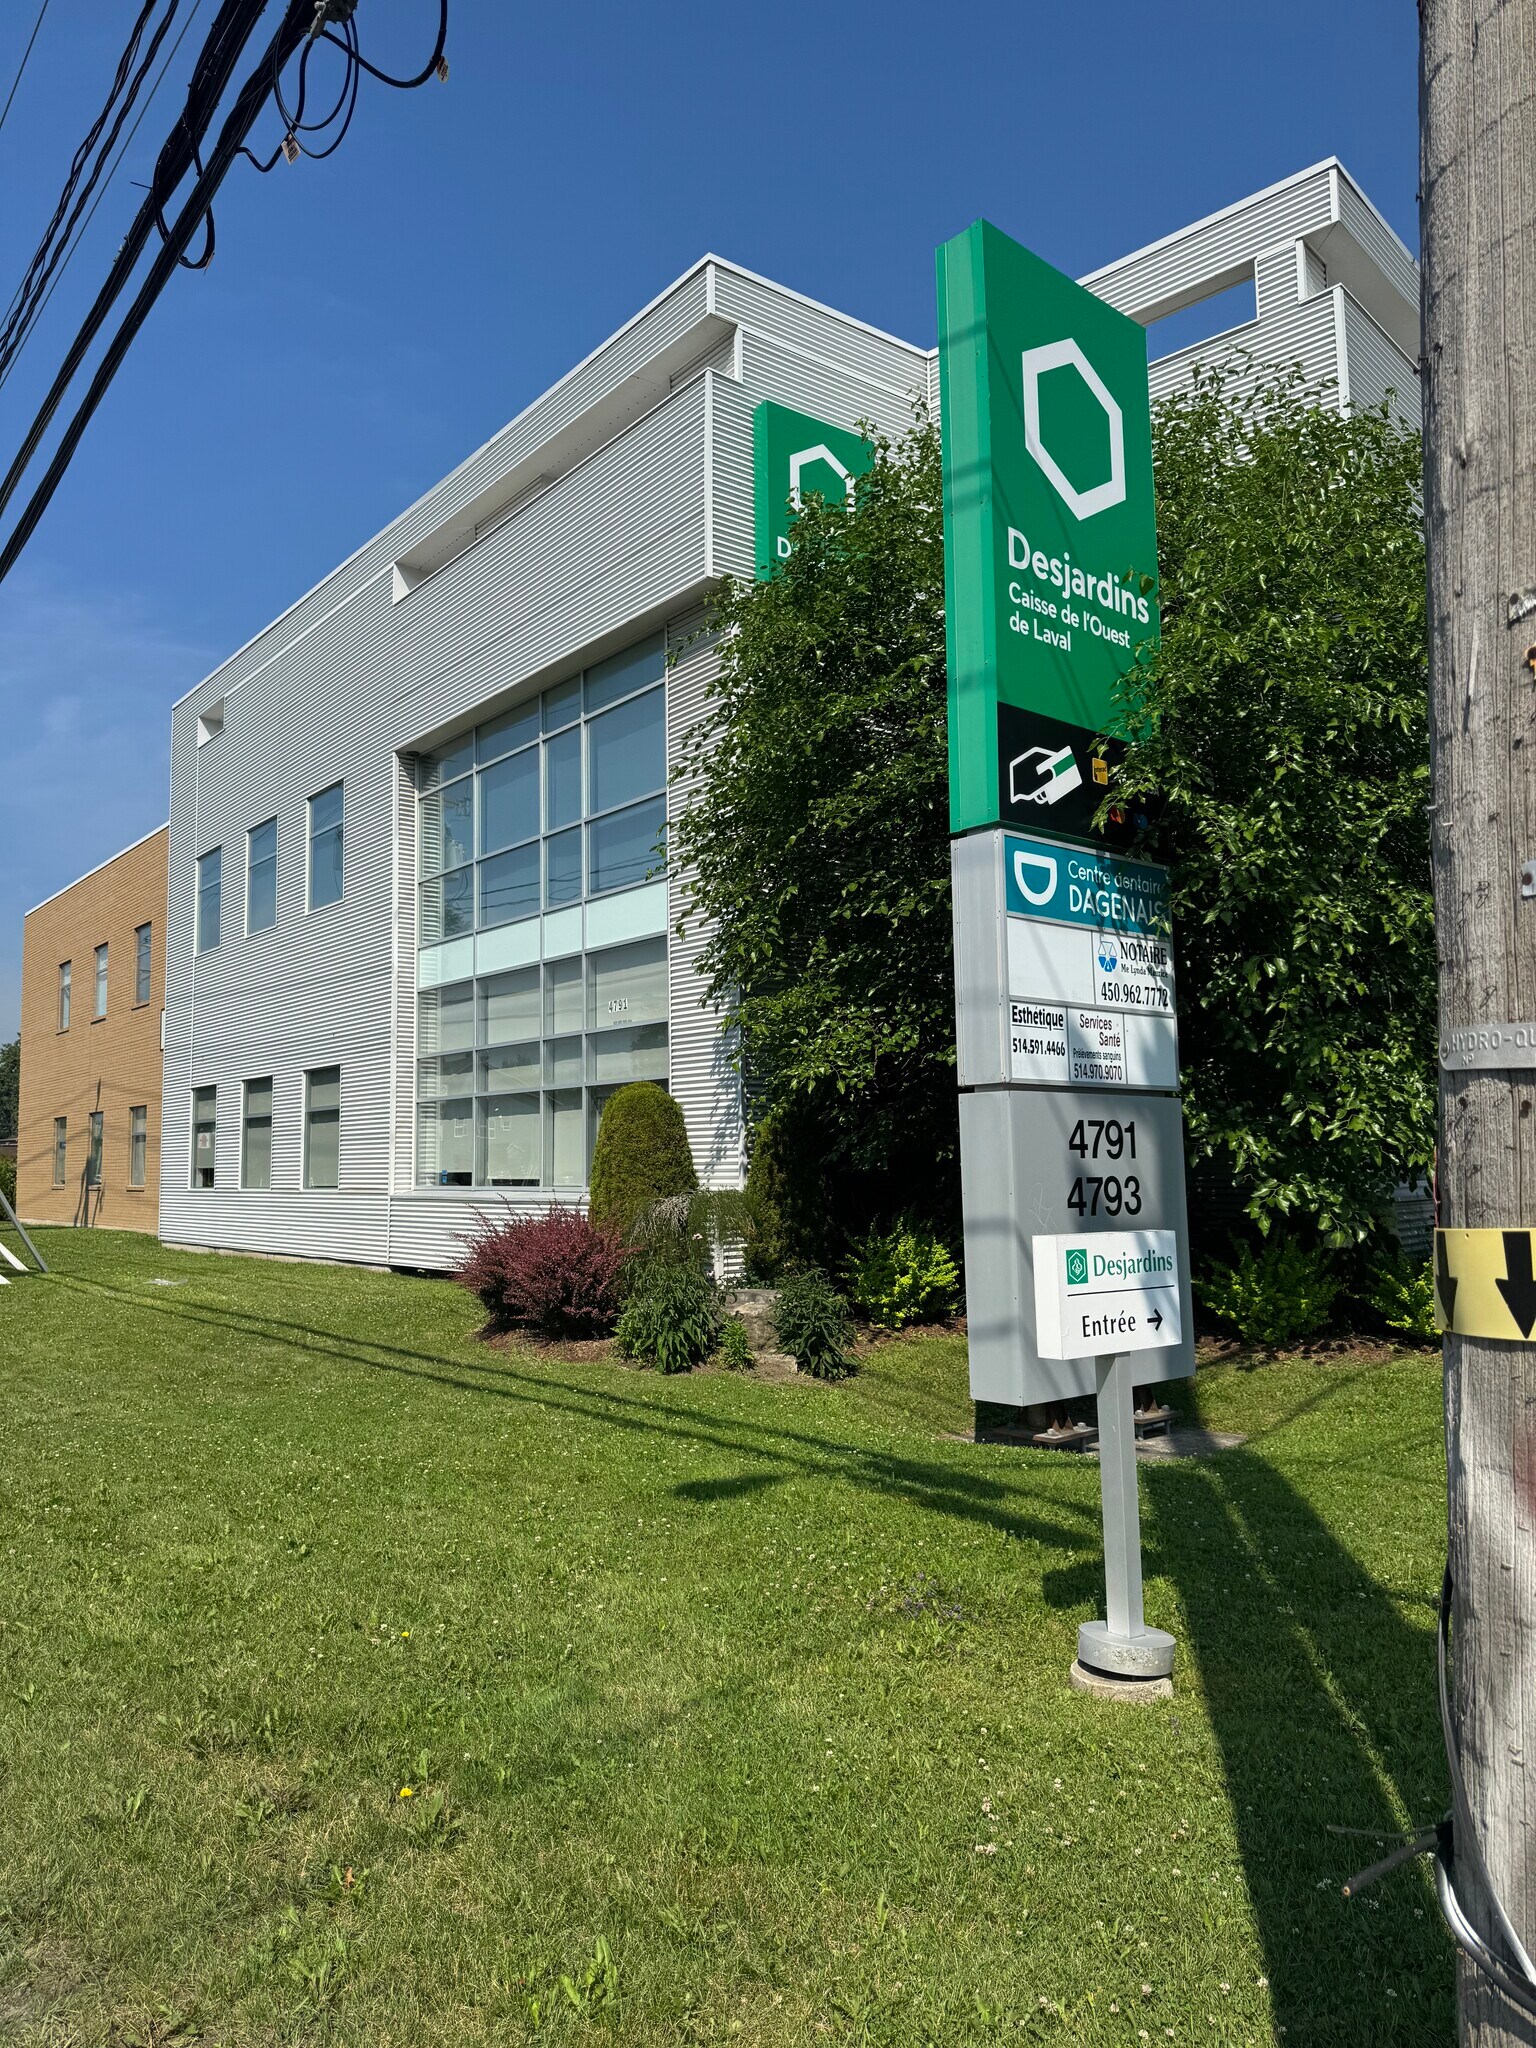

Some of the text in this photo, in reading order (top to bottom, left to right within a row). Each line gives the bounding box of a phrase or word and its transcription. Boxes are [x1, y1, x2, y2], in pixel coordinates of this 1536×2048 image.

[1008, 526, 1149, 624] Desjardins
[1009, 582, 1130, 649] Caisse de l'Ouest
[1009, 611, 1071, 651] de Laval
[1068, 860, 1111, 885] Centre
[1120, 942, 1167, 965] NOTAIRE
[1012, 1005, 1064, 1031] Esthétique
[1080, 1014, 1112, 1030] Services
[1012, 1038, 1066, 1057] 514.591.4466
[1099, 1032, 1121, 1047] Santé
[1074, 1063, 1122, 1080] 514.970.9070
[1068, 1119, 1137, 1160] 4791
[1067, 1175, 1142, 1217] 4793
[1093, 1249, 1173, 1281] Desjardins
[1082, 1310, 1137, 1338] Entrée
